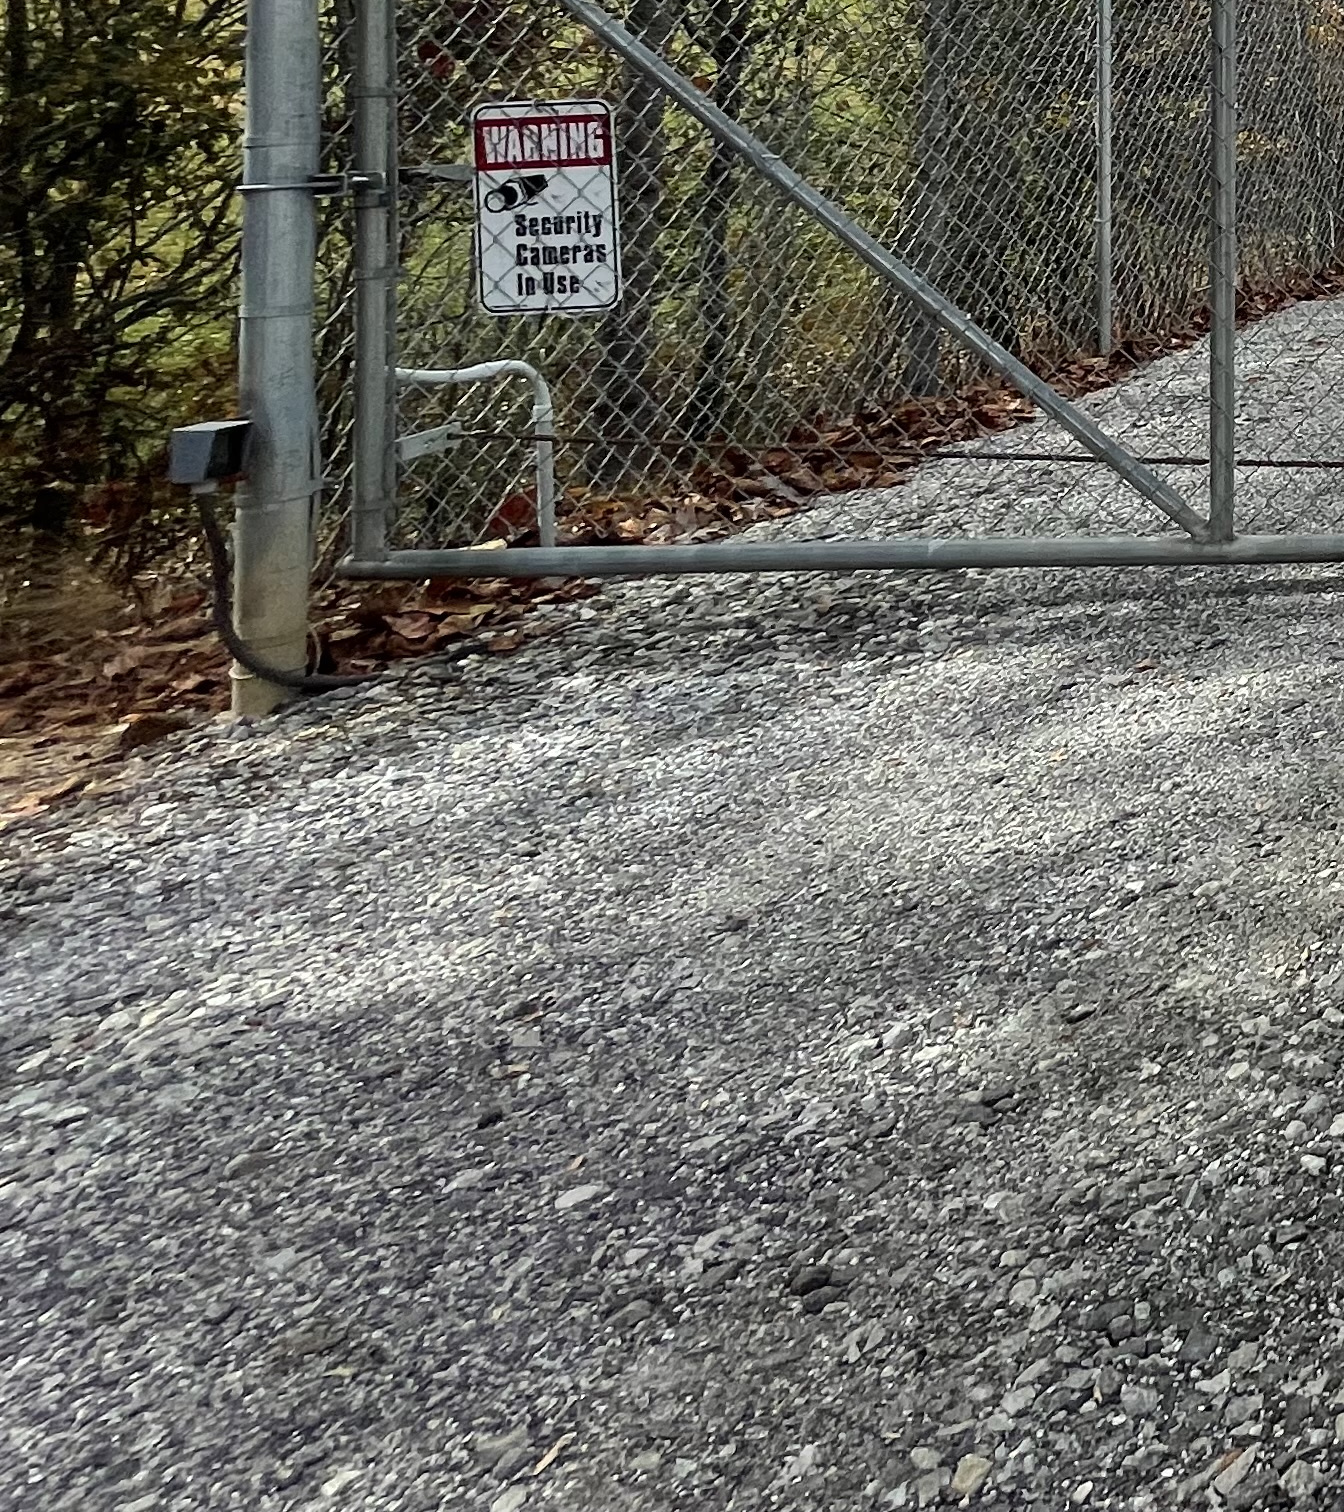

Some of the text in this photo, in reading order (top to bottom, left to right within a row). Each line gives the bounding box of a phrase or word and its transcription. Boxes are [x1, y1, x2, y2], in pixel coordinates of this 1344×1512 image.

[482, 121, 605, 164] WARNING
[514, 211, 603, 237] Security
[516, 243, 607, 266] Cameras
[517, 272, 580, 296] In Use
